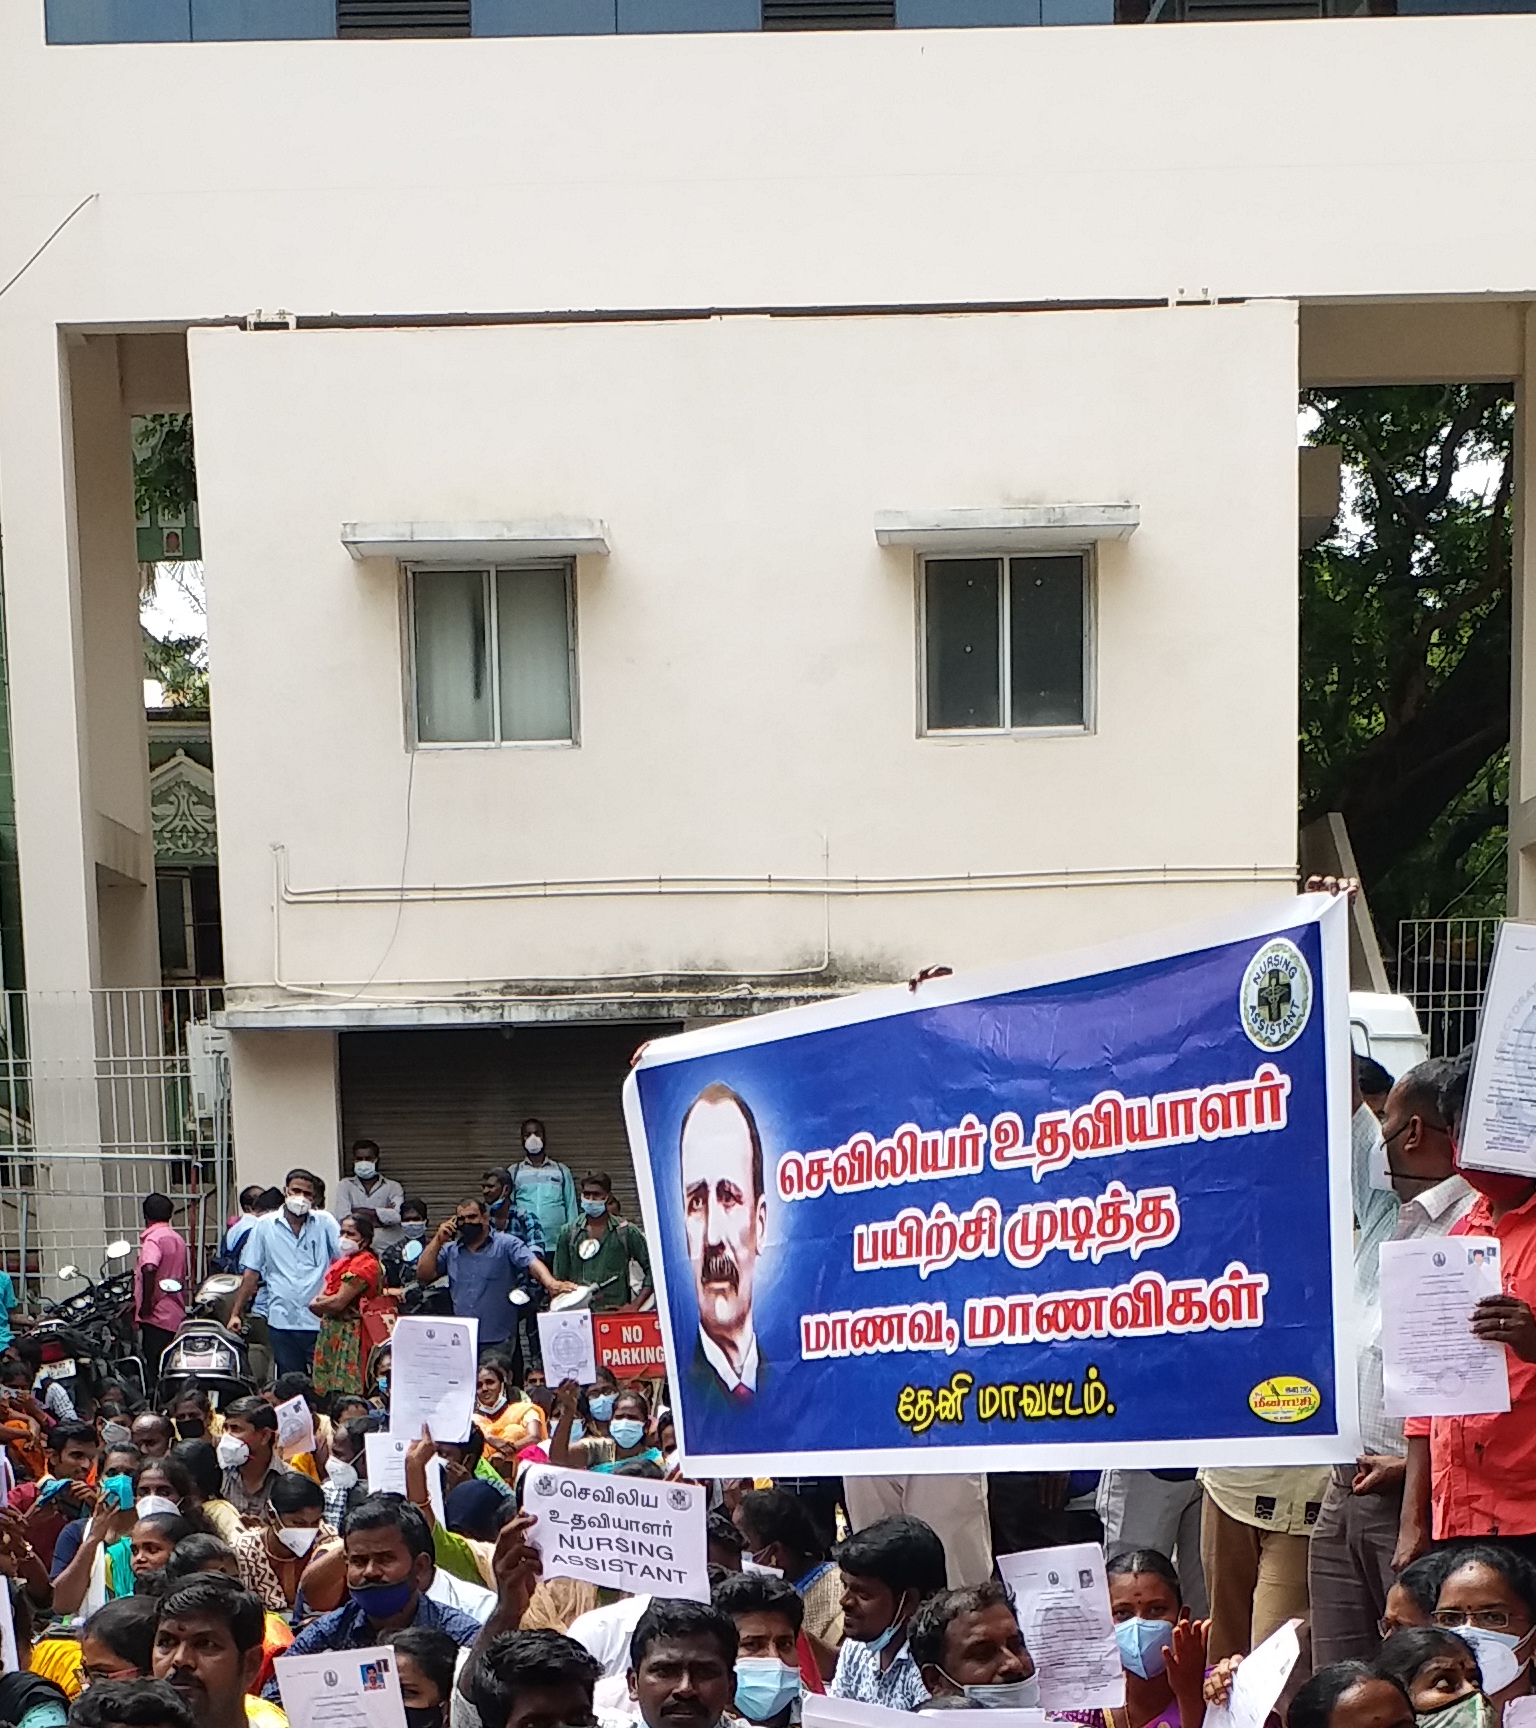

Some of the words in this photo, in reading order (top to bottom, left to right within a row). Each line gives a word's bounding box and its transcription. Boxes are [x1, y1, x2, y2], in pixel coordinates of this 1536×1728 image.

[1253, 954, 1297, 985] NURSING
[1249, 999, 1300, 1036] ASSISTANT
[779, 1122, 982, 1199] செவிலியர்
[994, 1070, 1285, 1176] உதவியாளர்
[856, 1201, 998, 1274] பயிற்சி
[1011, 1187, 1175, 1263] முடித்த
[804, 1305, 960, 1355] மாணவ,
[968, 1268, 1264, 1345] மாணவிகள்
[621, 1325, 643, 1344] NO
[602, 1346, 665, 1366] PARKING
[898, 1375, 972, 1431] தேனி
[978, 1367, 1115, 1419] மாவட்டம்.
[560, 1480, 658, 1509] செவிலிய
[549, 1509, 672, 1538] உதவியாளர்
[559, 1534, 674, 1561] NURSING
[552, 1554, 688, 1584] ASSISTANT
